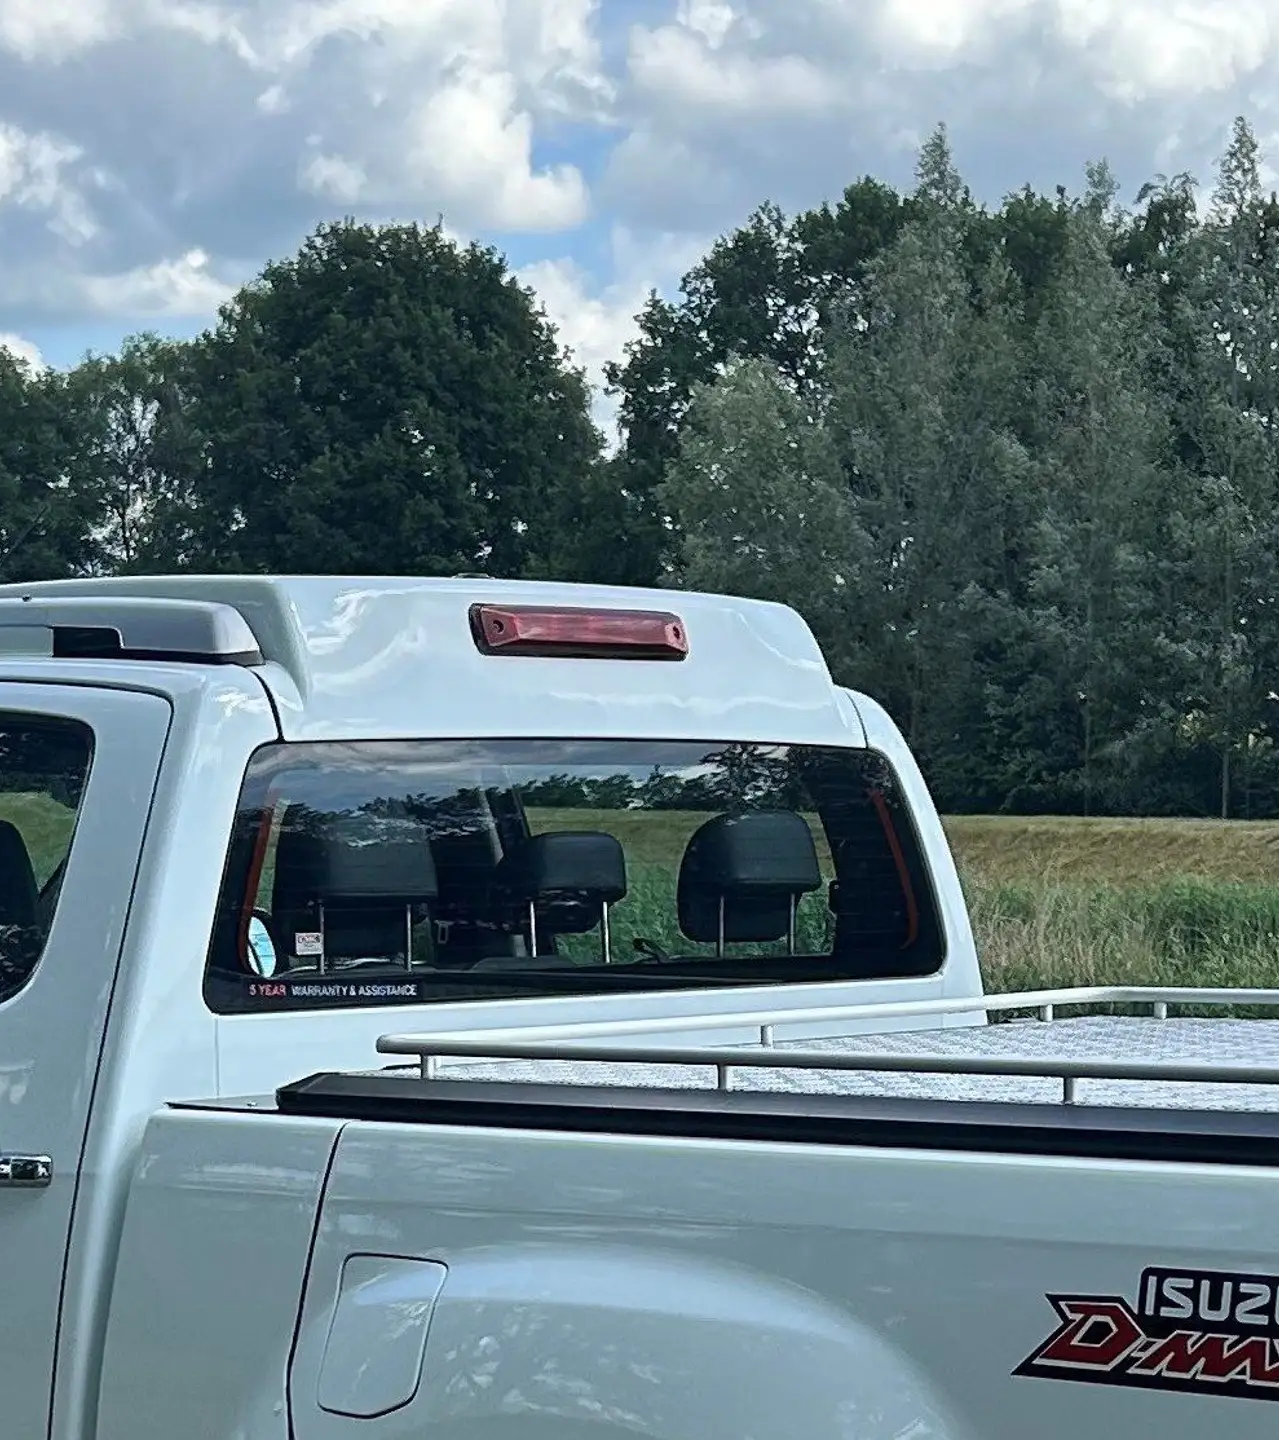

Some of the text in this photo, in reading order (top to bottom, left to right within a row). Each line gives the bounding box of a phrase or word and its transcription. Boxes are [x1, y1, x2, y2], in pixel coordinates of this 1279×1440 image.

[249, 984, 418, 997] 5 YEAR WARRANTY & ASSISTANCE
